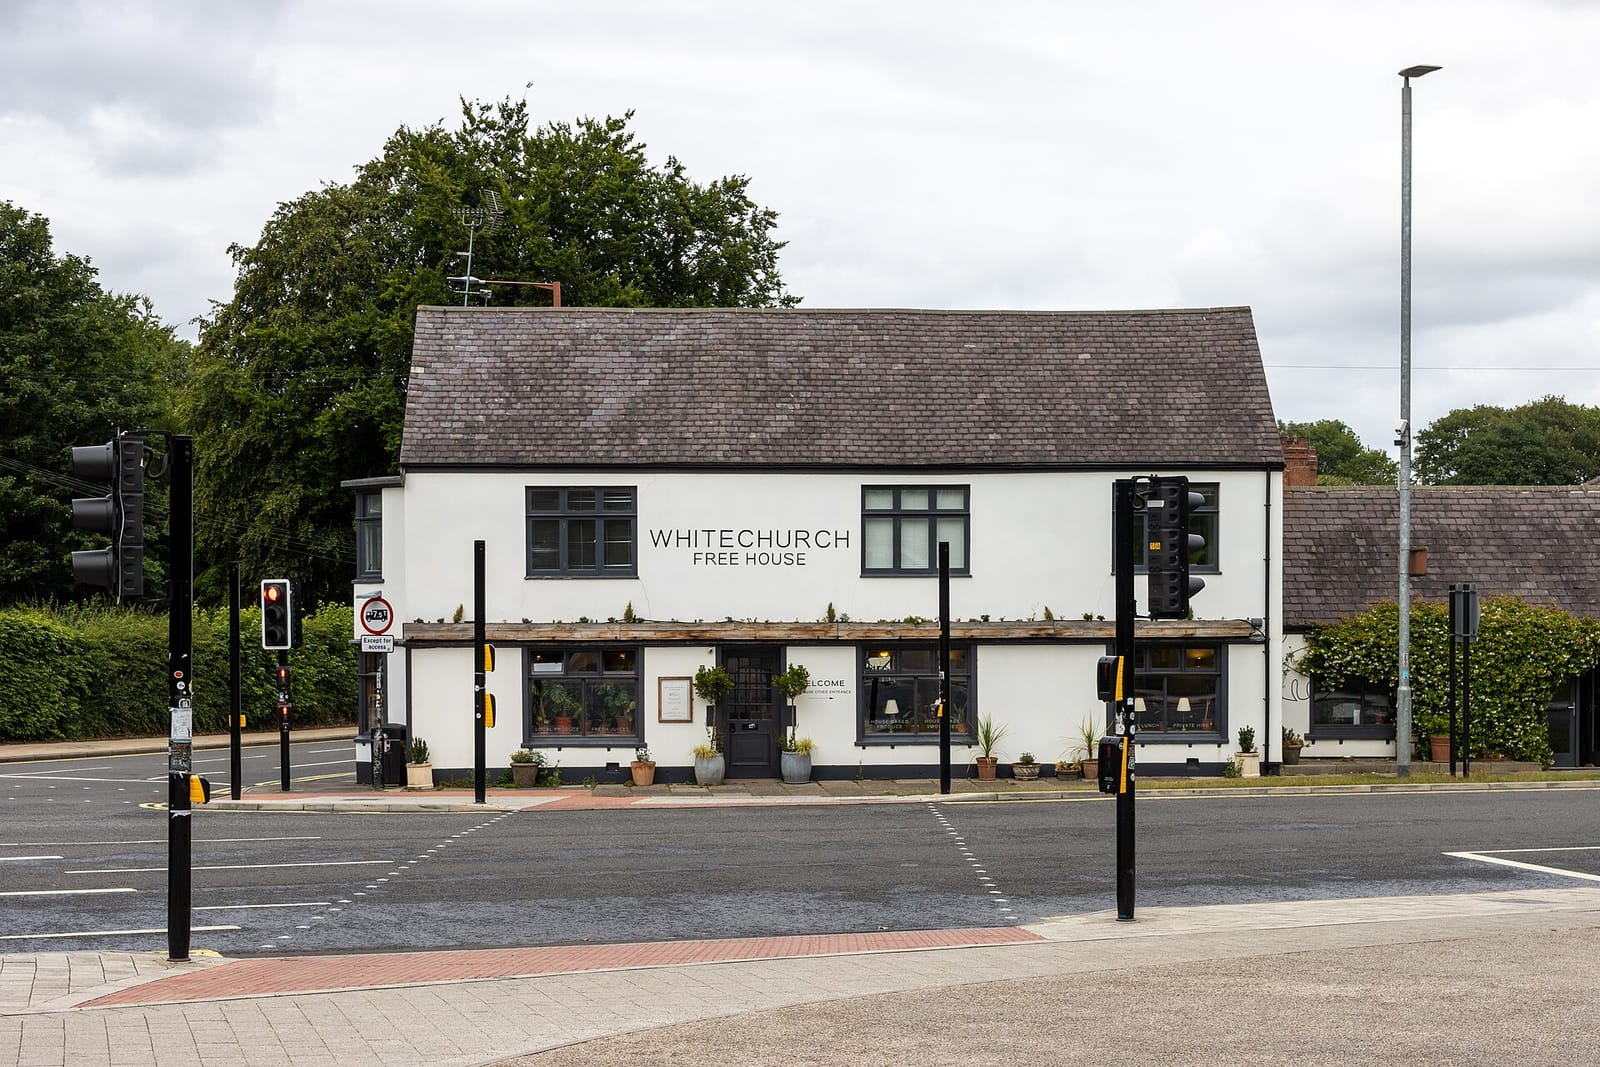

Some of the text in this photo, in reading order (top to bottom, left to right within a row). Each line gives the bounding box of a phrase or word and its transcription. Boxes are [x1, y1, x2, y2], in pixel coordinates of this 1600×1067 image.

[649, 529, 850, 548] WHITECHURCH
[693, 552, 806, 566] FREE HOUSE
